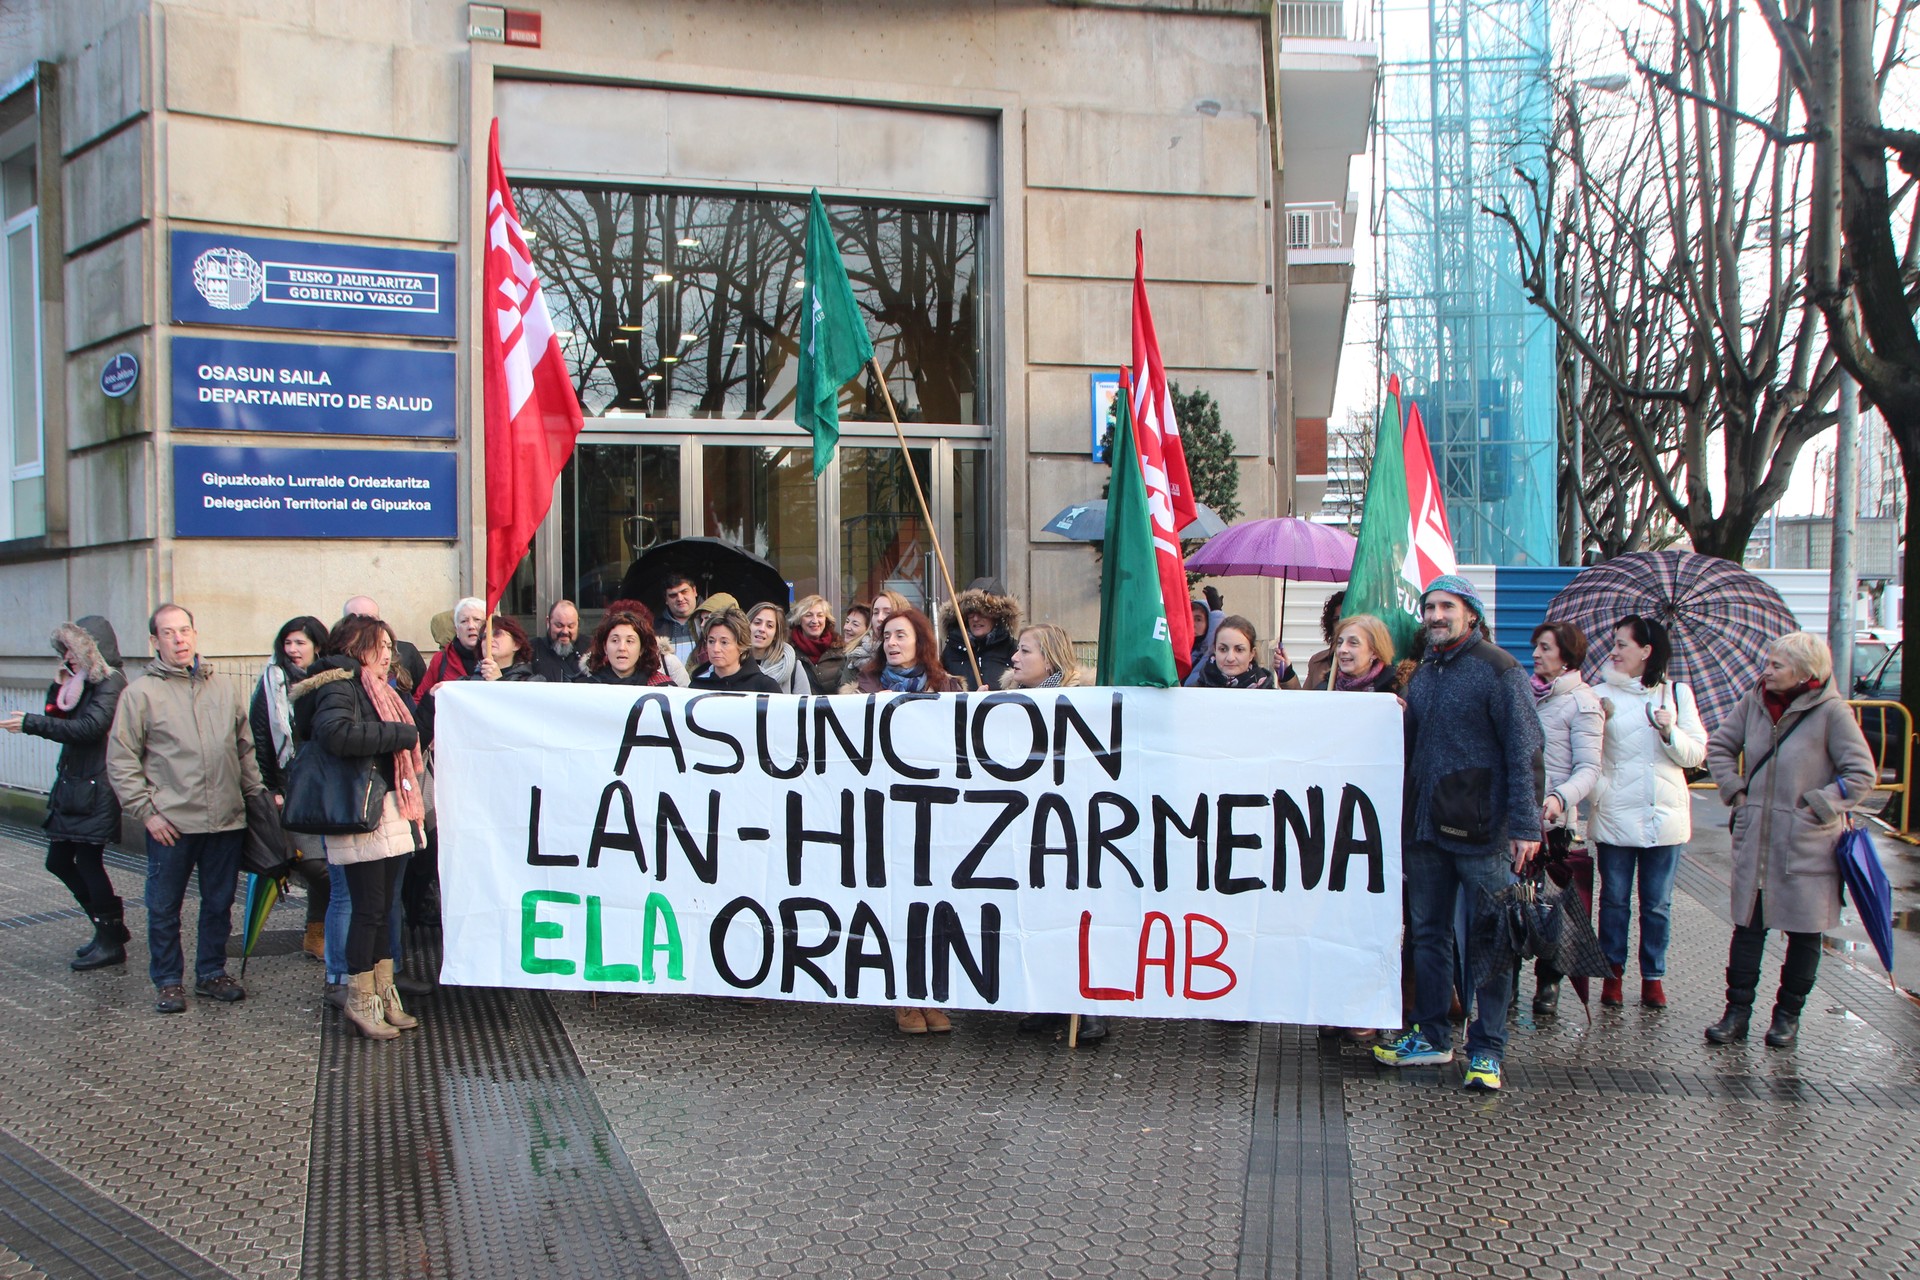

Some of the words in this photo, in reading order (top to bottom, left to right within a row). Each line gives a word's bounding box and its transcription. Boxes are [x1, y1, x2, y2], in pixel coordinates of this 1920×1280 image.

[289, 270, 333, 286] EUSKO
[337, 273, 422, 290] JAURLARITZA
[290, 287, 363, 303] GOBIERNO
[368, 292, 413, 305] VASCO
[198, 365, 275, 383] OSASUN
[279, 369, 332, 385] SAILA
[199, 387, 344, 408] DEPARTAMENTO
[349, 395, 372, 409] DE
[376, 397, 433, 412] SALUD
[202, 473, 285, 488] Gipuzkoako
[289, 475, 345, 488] Lurralde
[348, 476, 430, 489] Ordezkaritza
[204, 496, 281, 512] Delegación
[284, 498, 348, 510] Territorial
[352, 498, 368, 511] de
[372, 499, 432, 512] Gipuzkoa
[613, 692, 1123, 786] ASUNCION
[526, 780, 1386, 895] LAN-HITZARMENA
[520, 890, 687, 984] ELA
[709, 896, 1001, 1004] ORAIN
[1078, 910, 1237, 1001] LAB
